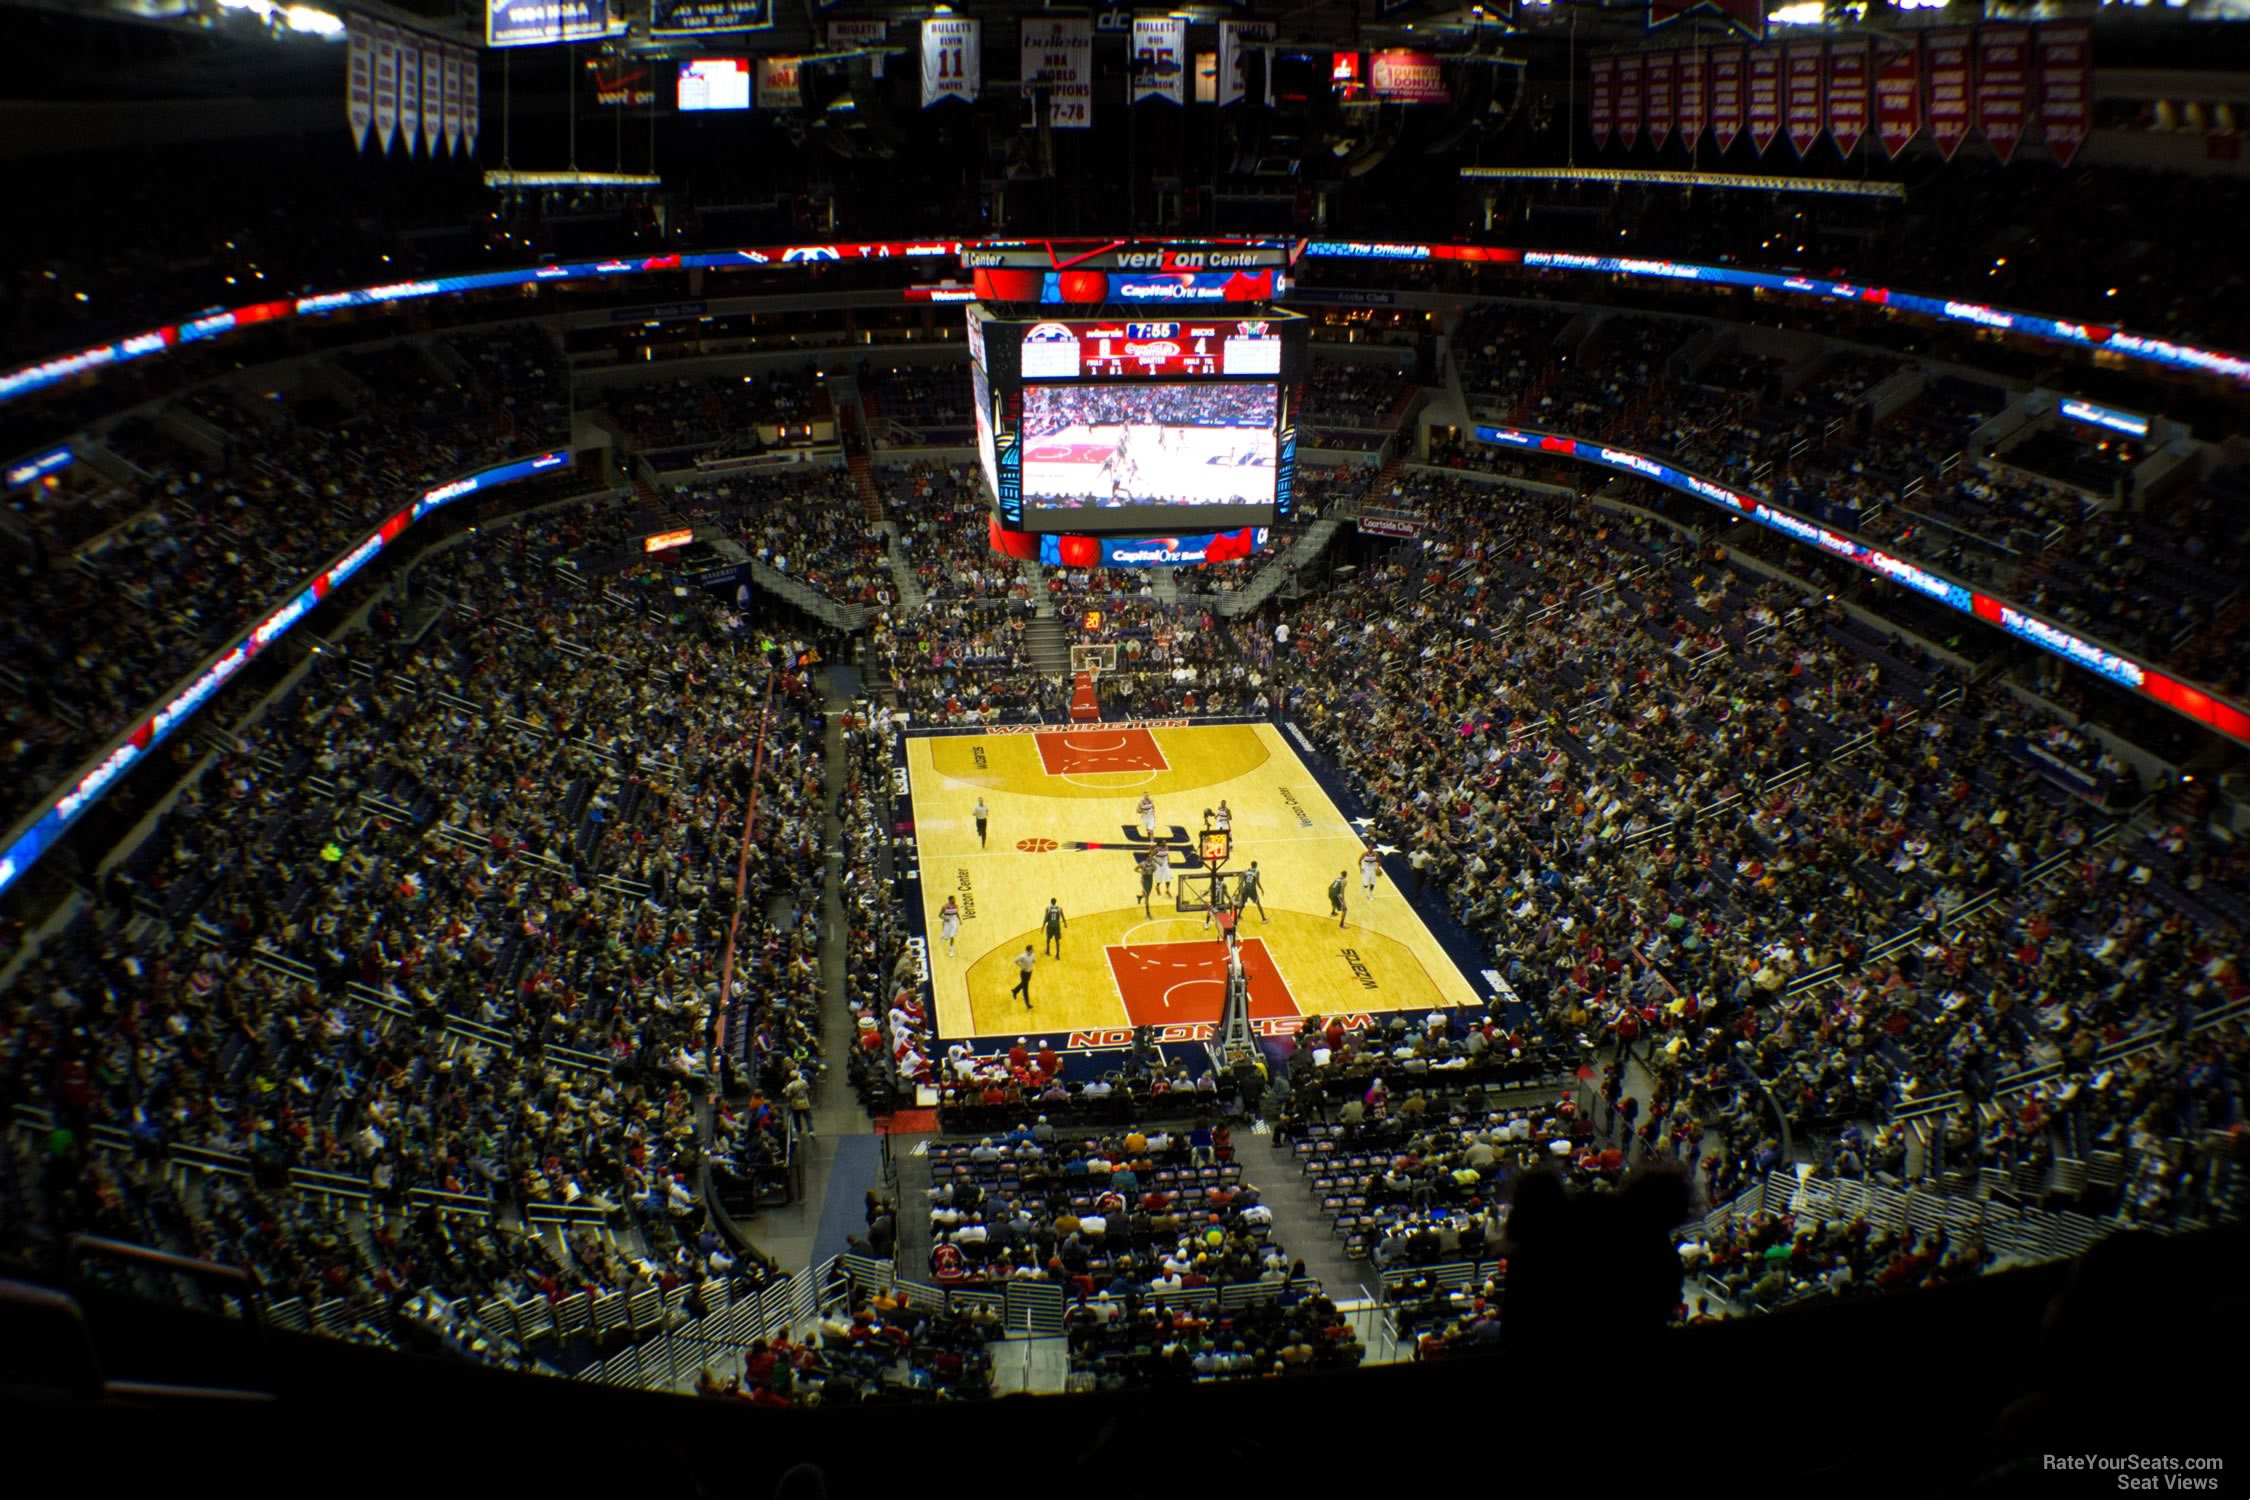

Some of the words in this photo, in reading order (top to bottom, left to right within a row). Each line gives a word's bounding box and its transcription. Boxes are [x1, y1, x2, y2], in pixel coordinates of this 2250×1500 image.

[545, 2, 589, 19] NCAA
[931, 23, 972, 33] BULLETS
[1136, 23, 1176, 32] BULLETS
[940, 37, 962, 46] ELVIN
[938, 48, 963, 77] 11
[1043, 54, 1067, 66] NBA
[1036, 69, 1076, 81] WORLD
[939, 82, 962, 90] HAYES
[971, 254, 1003, 266] Center
[1117, 248, 1204, 271] verizon
[1209, 253, 1258, 266] Center
[1198, 287, 1224, 298] Bank
[1190, 328, 1215, 337] BUCKS
[1195, 337, 1206, 356] 4
[1364, 518, 1397, 531] Courtside
[1398, 522, 1414, 532] Club
[1182, 550, 1206, 561] Bank
[1086, 617, 1098, 628] 20
[2001, 607, 2024, 628] The
[2024, 618, 2069, 650] Official
[986, 719, 1189, 736] WASHINGTON
[1278, 786, 1299, 806] Center
[1291, 806, 1313, 828] Verizon
[1206, 844, 1224, 857] 20
[957, 868, 972, 891] Center
[961, 890, 977, 920] Verizon
